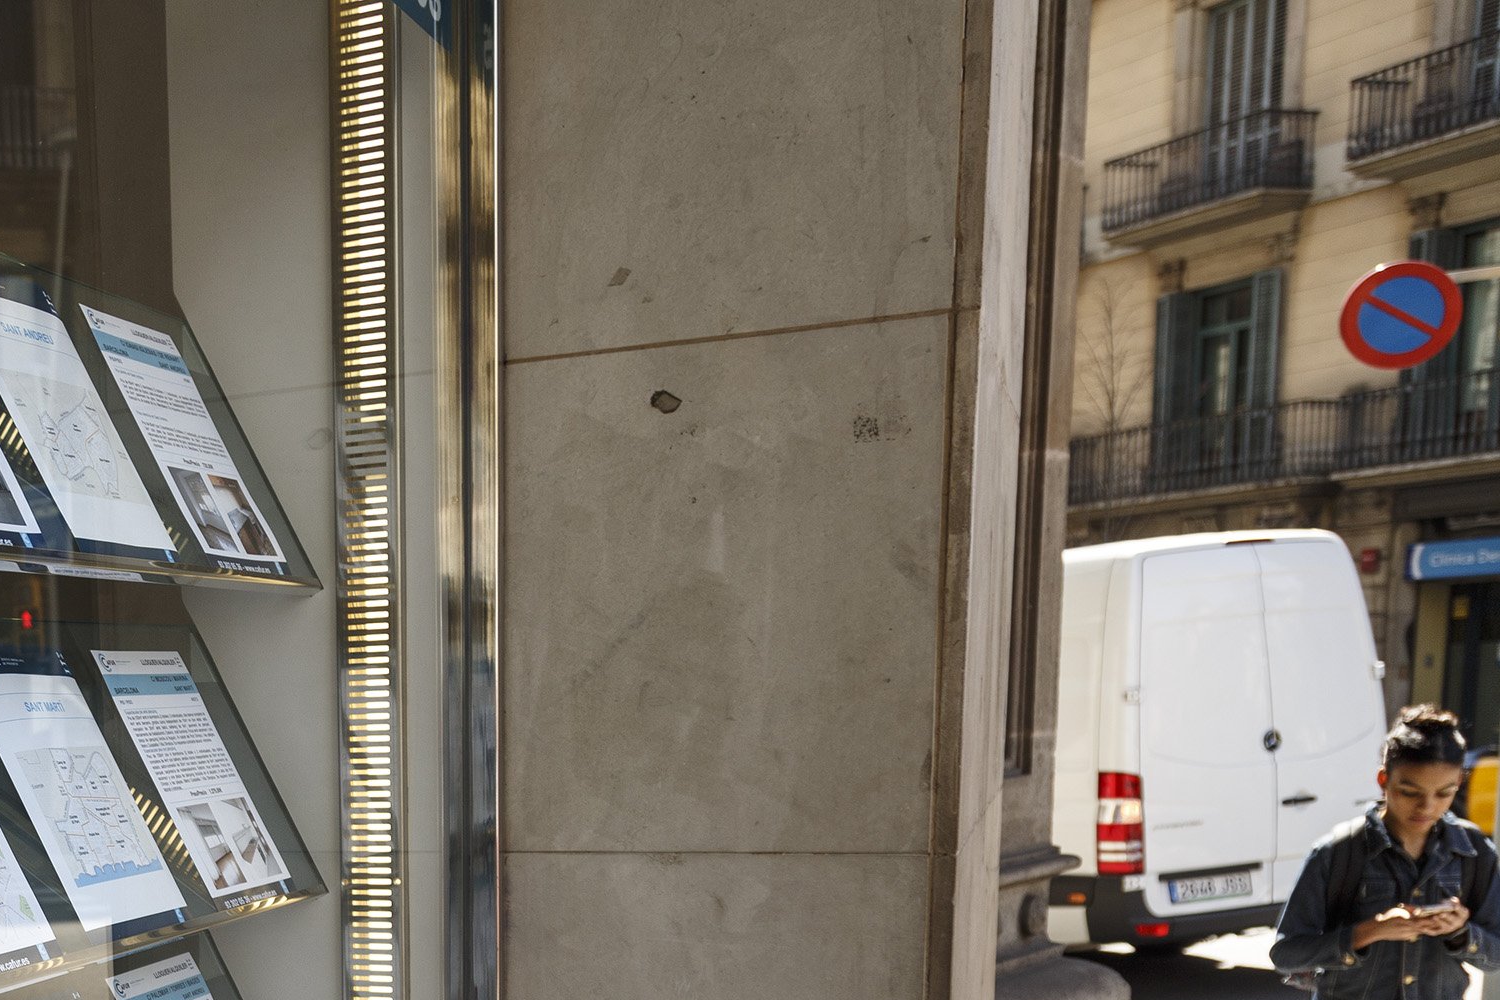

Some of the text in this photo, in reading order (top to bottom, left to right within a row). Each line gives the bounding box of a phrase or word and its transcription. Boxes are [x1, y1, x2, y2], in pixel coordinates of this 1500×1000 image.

[0, 321, 54, 344] SANT ANDREU
[25, 701, 43, 712] SANT
